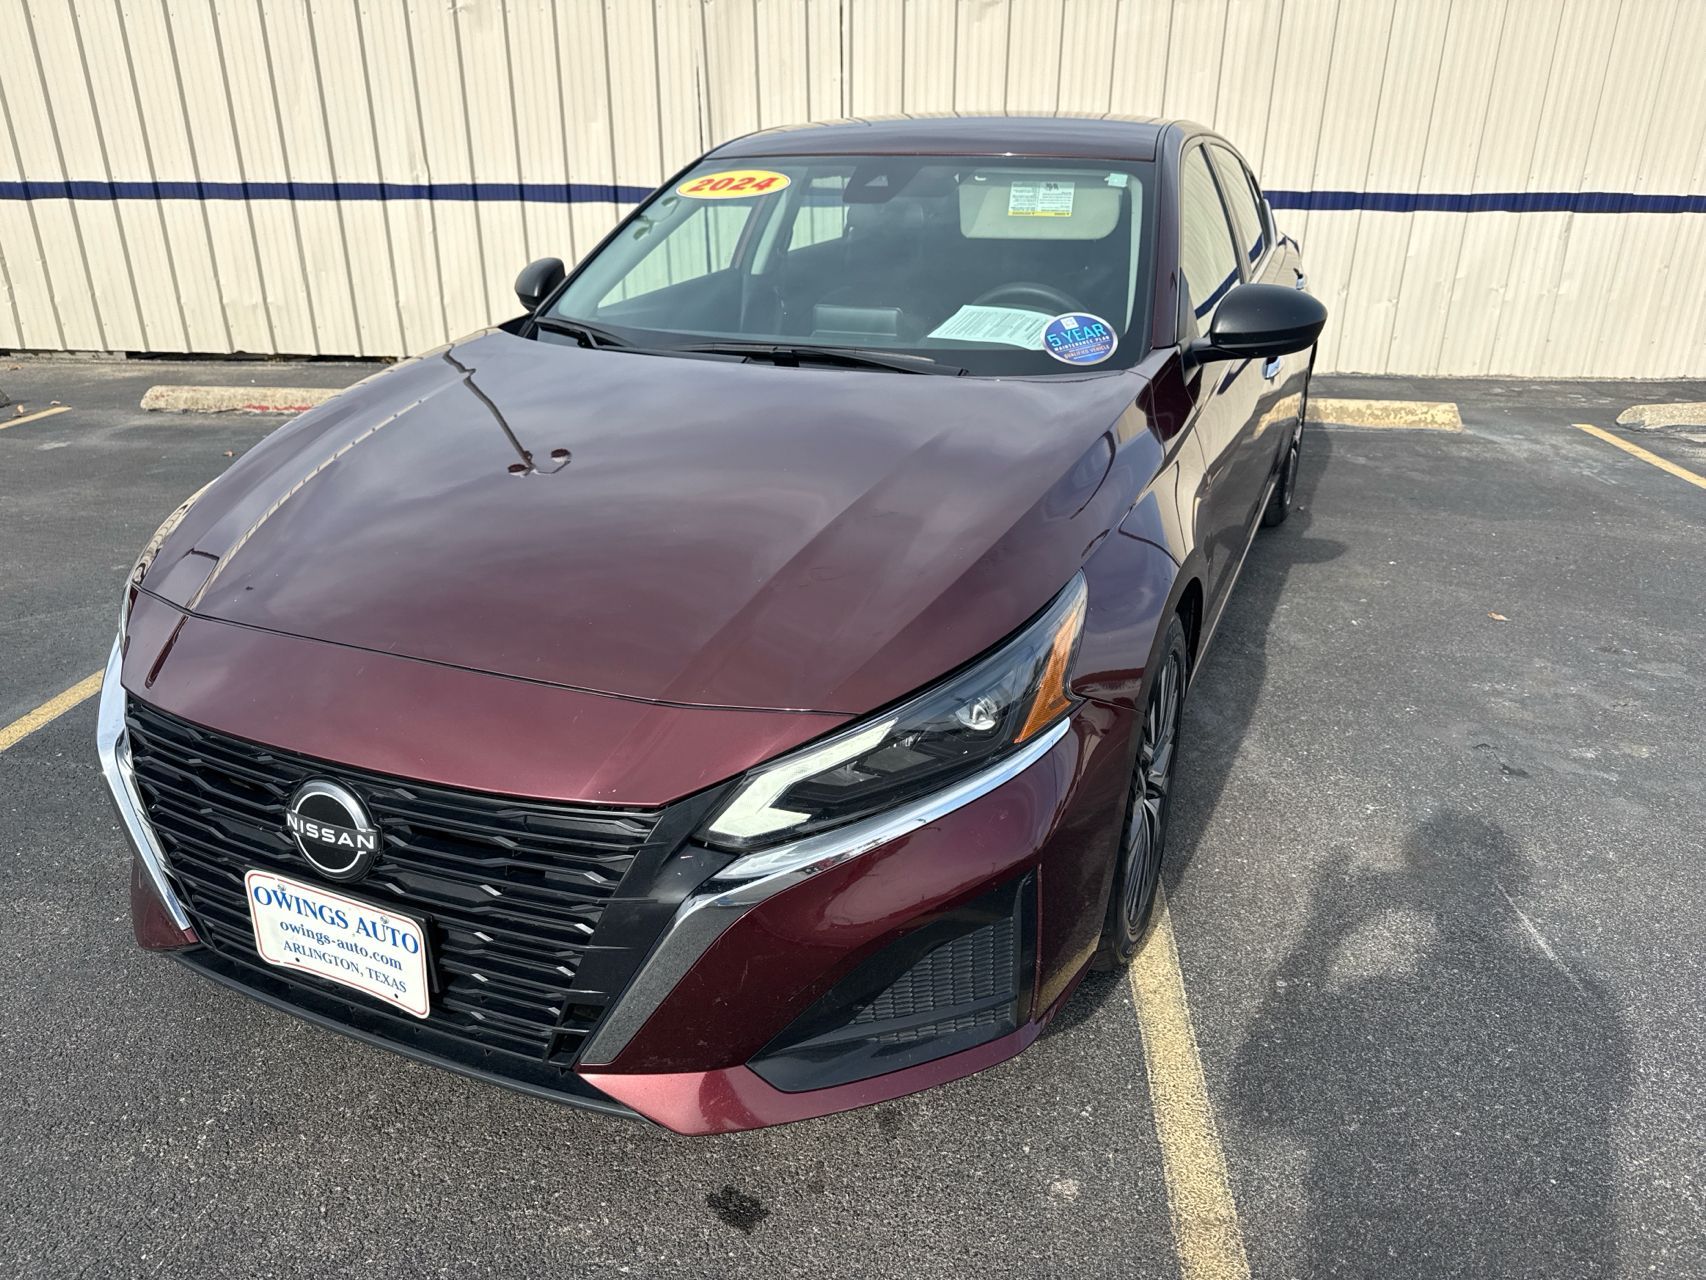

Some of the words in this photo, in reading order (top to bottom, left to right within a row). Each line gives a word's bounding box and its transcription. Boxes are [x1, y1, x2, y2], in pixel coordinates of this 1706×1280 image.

[687, 177, 779, 192] 2024
[1047, 333, 1062, 347] 5
[1060, 323, 1107, 343] YEAR
[1054, 339, 1093, 351] MAINTENANCE
[1094, 335, 1110, 343] PLAN
[1090, 344, 1110, 353] VEHICLE
[286, 812, 375, 850] NISSAN
[253, 886, 349, 929] OWINGS
[356, 916, 419, 954] AUTO
[280, 921, 403, 971] owings-auto.com
[283, 940, 365, 977] ARLINGTON,
[365, 966, 407, 993] TEXAS
